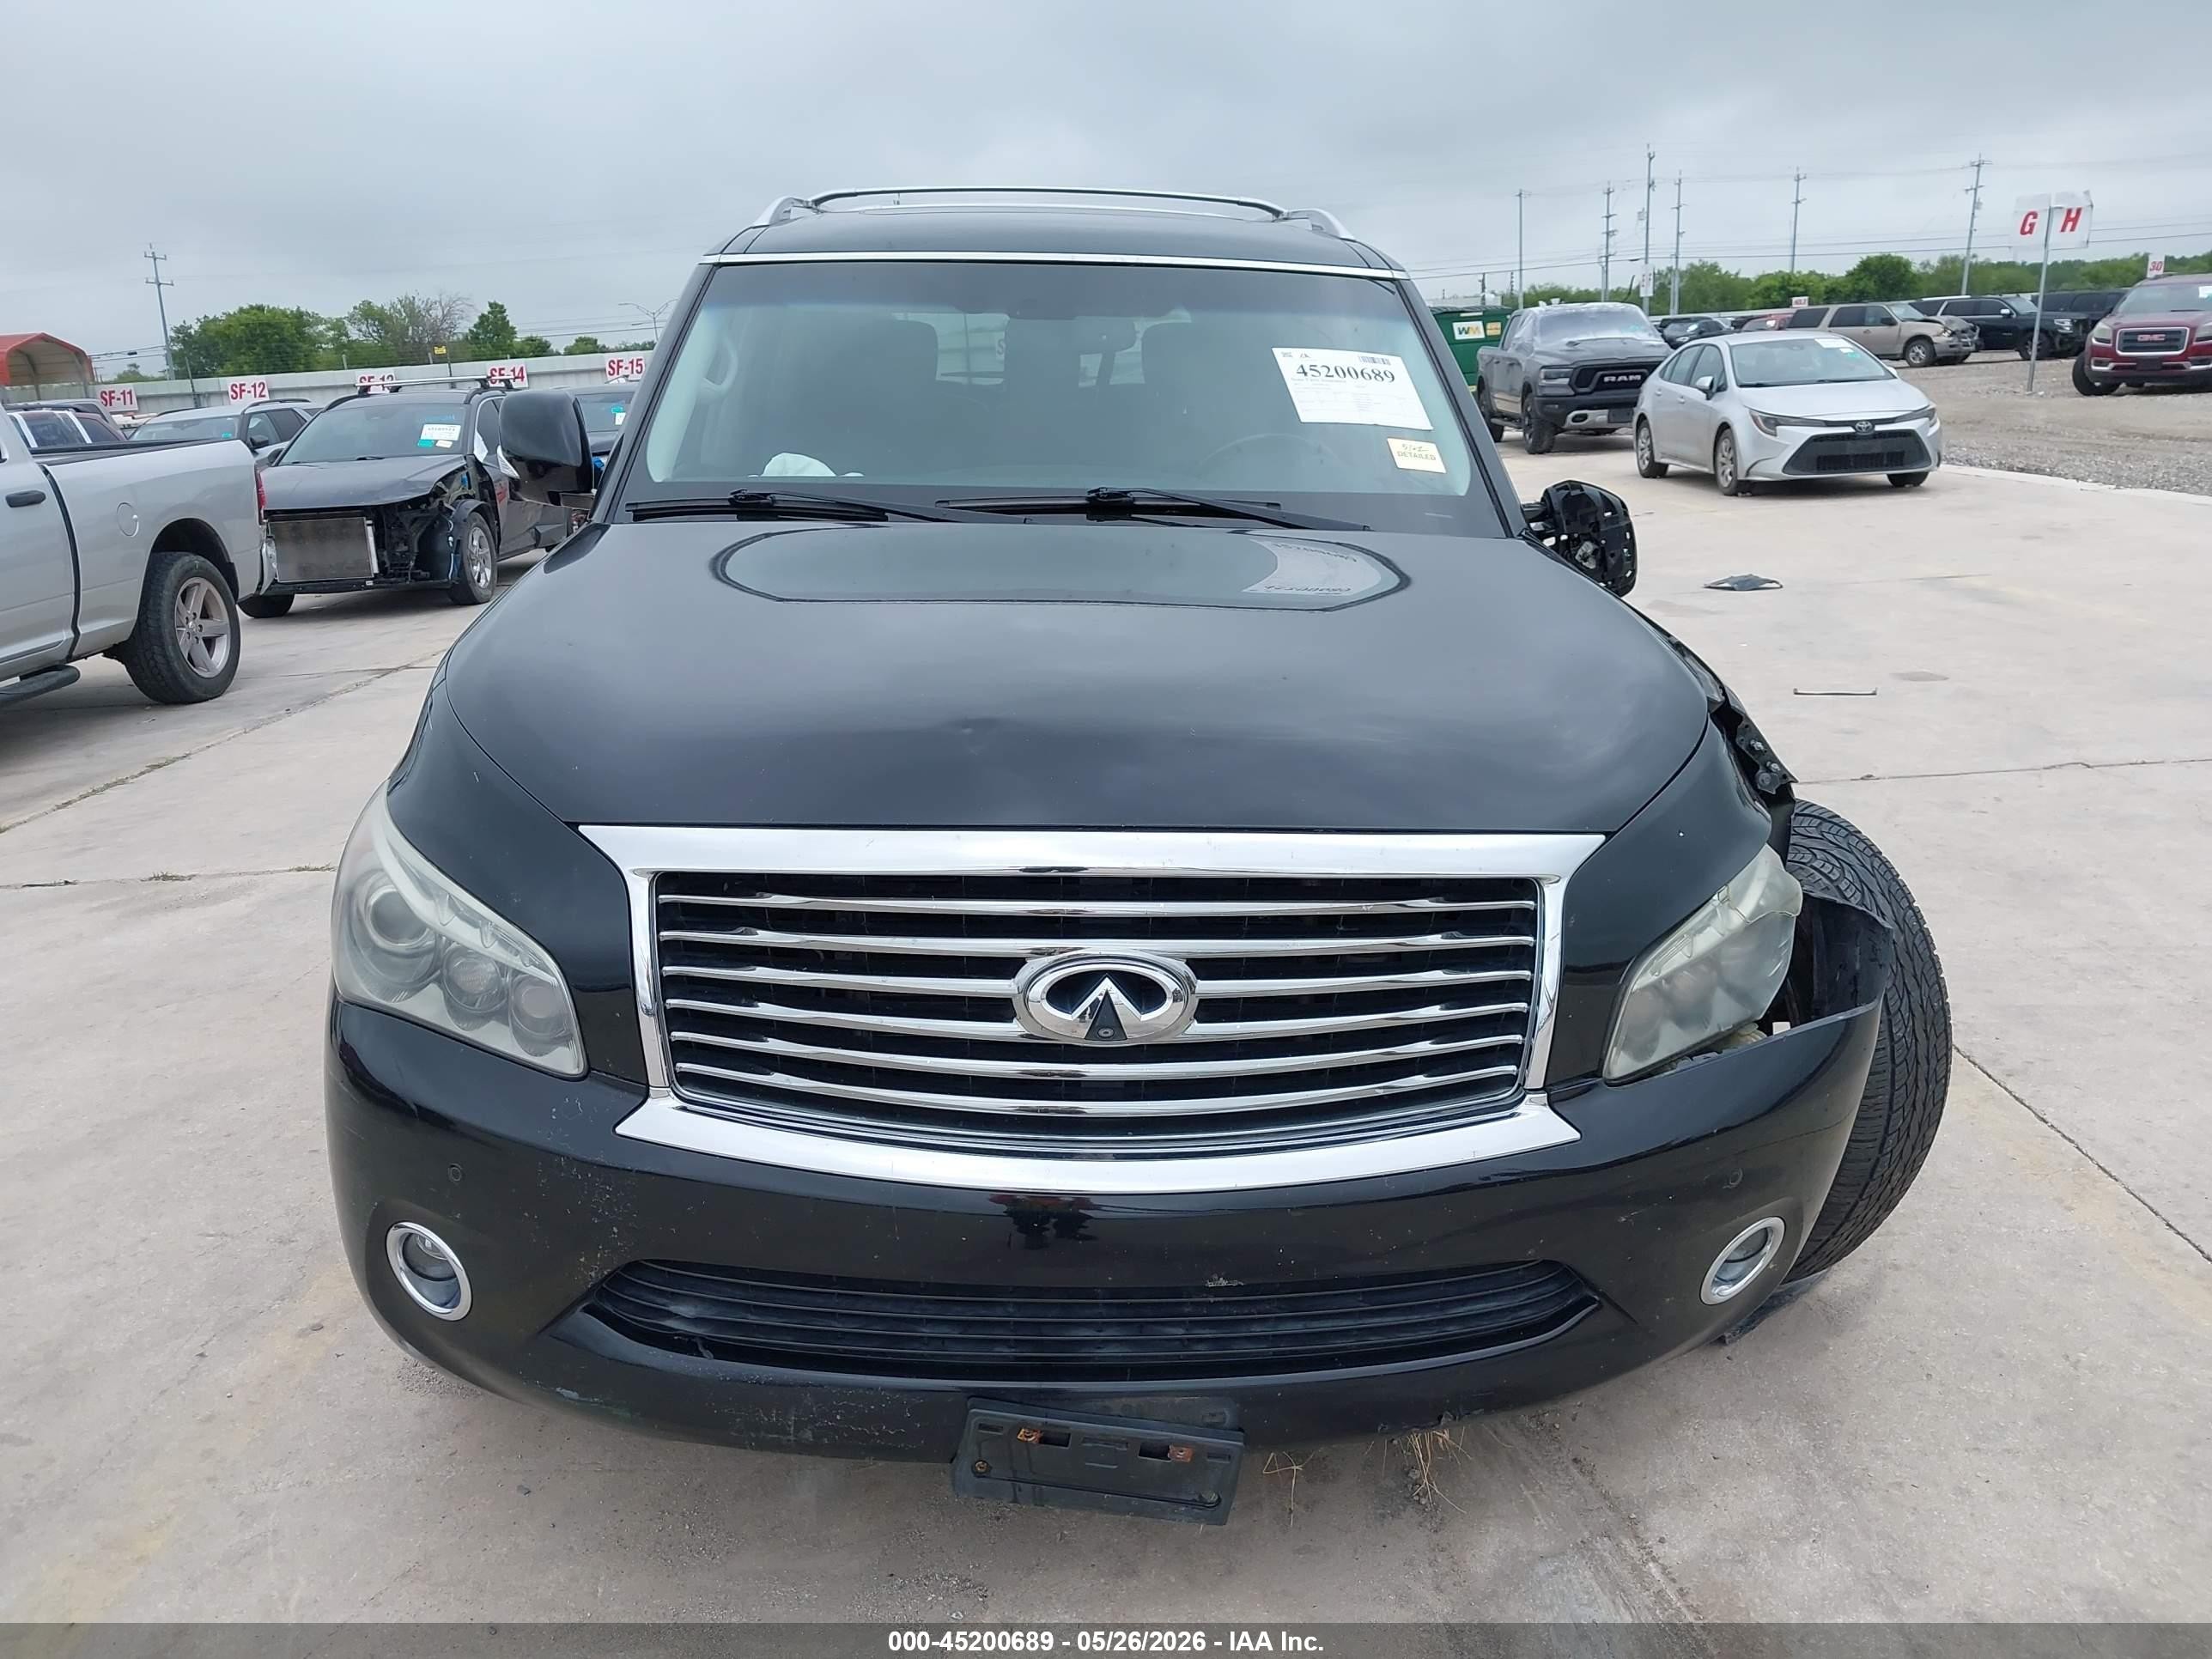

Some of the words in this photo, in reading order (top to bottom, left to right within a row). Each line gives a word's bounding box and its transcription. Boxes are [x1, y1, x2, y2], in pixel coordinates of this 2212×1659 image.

[2020, 210, 2039, 235] G
[2060, 207, 2082, 232] H
[1457, 326, 1481, 335] WM
[608, 358, 643, 376] SF-15
[1296, 364, 1395, 383] 45200689
[100, 389, 133, 407] SF-11
[230, 381, 266, 400] SF-12
